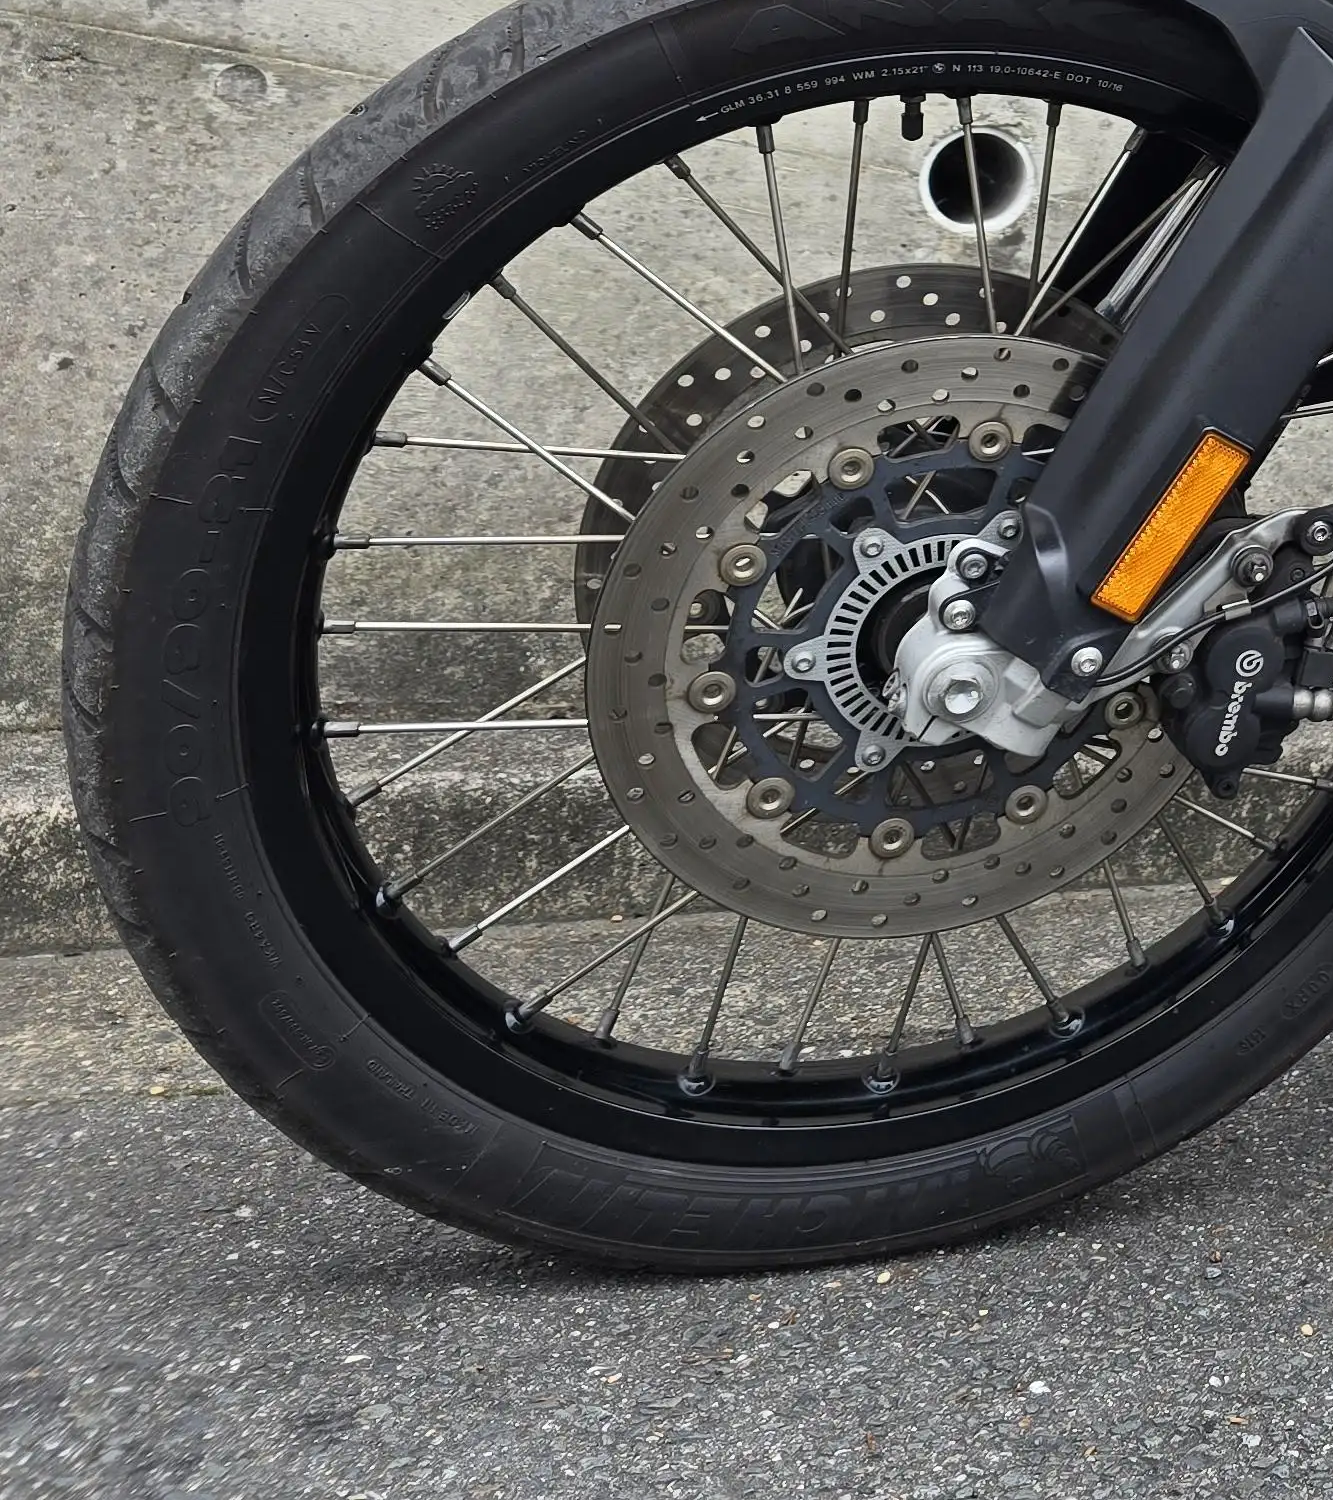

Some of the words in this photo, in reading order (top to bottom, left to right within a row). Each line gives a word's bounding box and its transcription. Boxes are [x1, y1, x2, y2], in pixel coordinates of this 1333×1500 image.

[720, 100, 746, 114] GLM
[748, 88, 780, 105] 36.31
[784, 85, 792, 95] 8
[796, 80, 818, 92] 559
[824, 75, 846, 86] 994
[852, 70, 875, 81] WM
[952, 64, 961, 72] N
[967, 64, 983, 73] 113
[990, 65, 1062, 80] 19.0-10642-E
[1066, 73, 1093, 84] DOT
[1214, 680, 1253, 758] brembo
